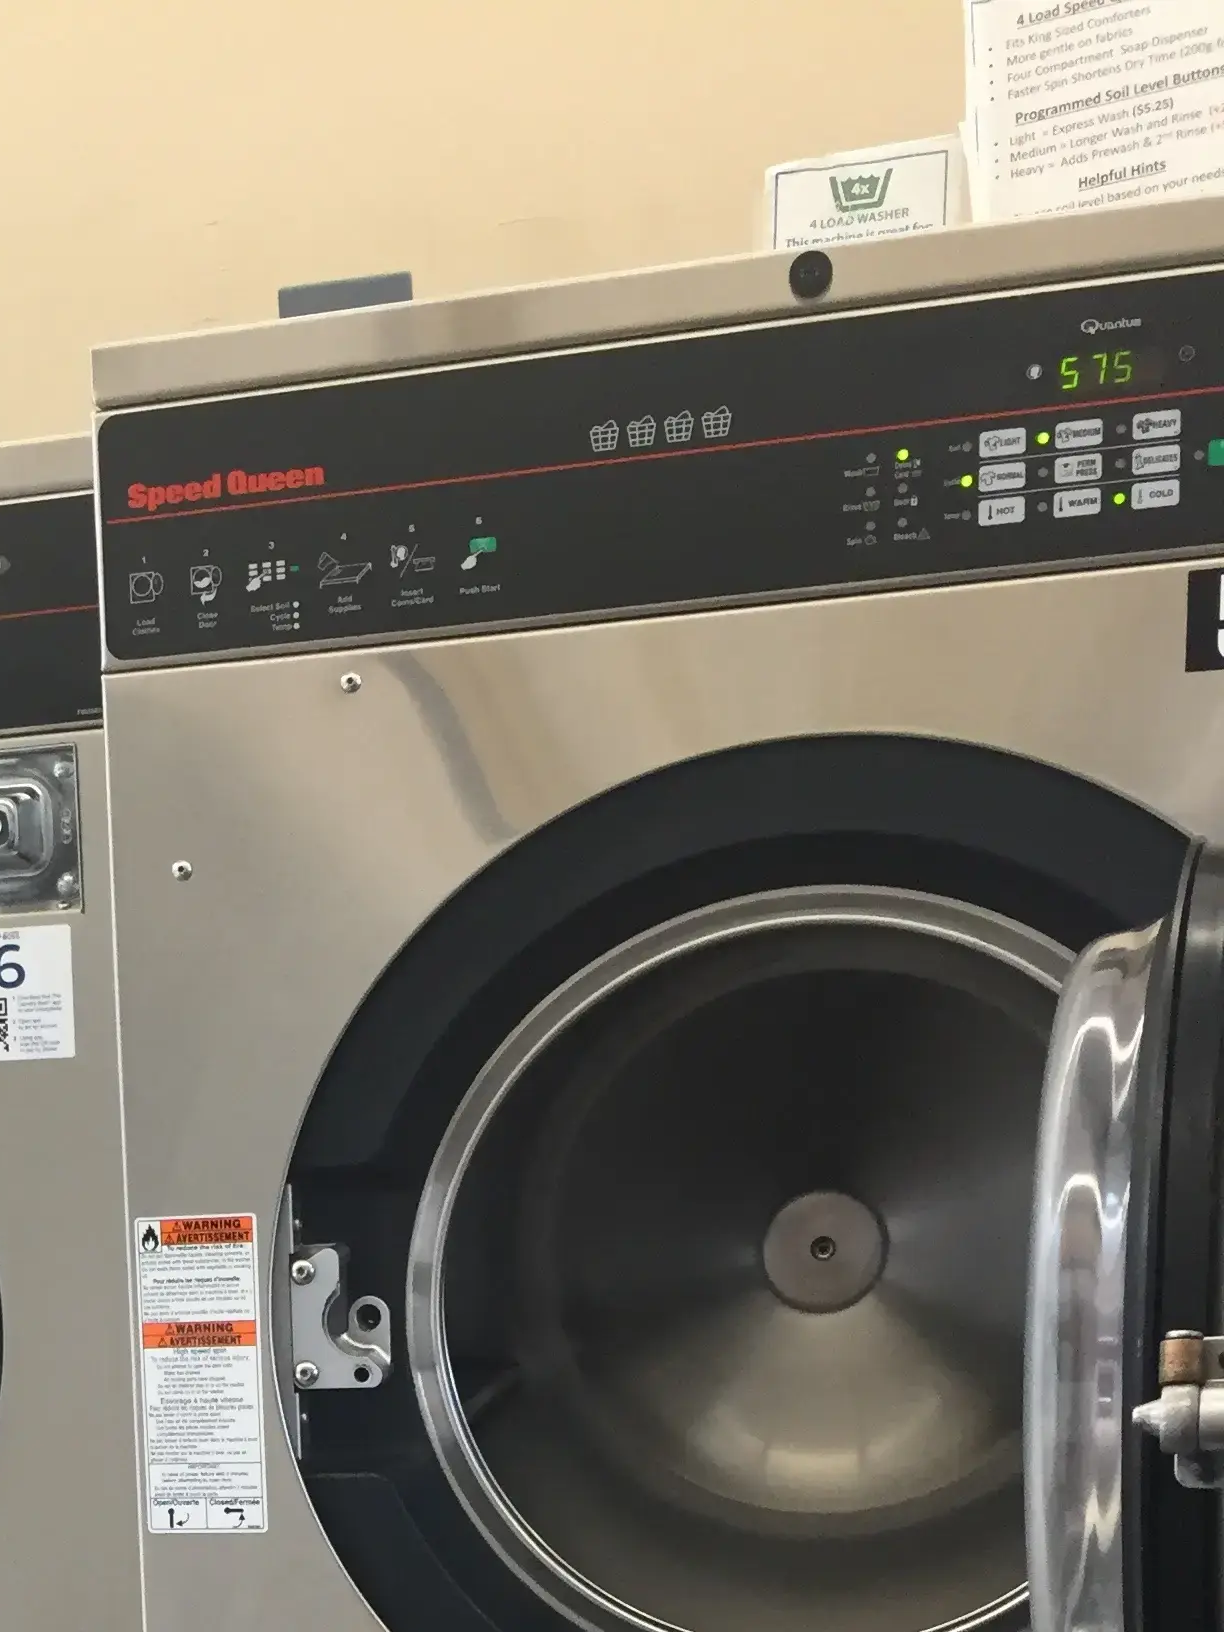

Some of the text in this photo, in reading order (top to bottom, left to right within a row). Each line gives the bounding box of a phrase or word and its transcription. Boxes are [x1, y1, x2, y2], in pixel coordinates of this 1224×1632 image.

[1017, 14, 1025, 26] 4
[1029, 4, 1060, 23] Load
[1006, 38, 1025, 50] Fits
[1028, 30, 1052, 45] King
[1087, 6, 1151, 30] Comforters
[1006, 27, 1134, 67] More gentle on fabrics
[1007, 69, 1032, 83] Four
[1035, 48, 1114, 76] Compartment
[1120, 38, 1148, 55] Soap
[1151, 26, 1208, 47] Dispenser
[1007, 85, 1040, 100] Faster
[1044, 76, 1068, 92] Spin
[1071, 65, 1122, 84] Shortens
[1125, 57, 1145, 72] Dry
[1148, 51, 1176, 66] Time
[1015, 64, 1224, 124] Programmed Soil Level Buttons
[1010, 132, 1036, 147] Light
[1052, 118, 1095, 137] Express
[1097, 109, 1129, 125] Wash
[1132, 96, 1174, 119] ($5.25)
[1010, 143, 1057, 163] Medium
[1070, 131, 1108, 149] Longer
[1111, 121, 1143, 138] Wash
[1146, 116, 1167, 131] and
[1010, 162, 1044, 180] Heavy
[1060, 153, 1089, 168] Adds
[1091, 140, 1140, 160] Prewash
[1143, 136, 1152, 148] &
[1078, 159, 1167, 189] Helpful Hints
[1078, 194, 1104, 208] level
[1107, 186, 1141, 203] based
[1144, 184, 1159, 195] on
[1162, 177, 1188, 192] your
[809, 207, 910, 229] 4 LOAD WASHER
[1152, 418, 1177, 429] HEAVY
[999, 437, 1021, 447] LIGHT
[127, 466, 325, 511] Speed Queen
[1149, 489, 1174, 499] COLD
[996, 506, 1015, 515] HOT
[1068, 497, 1098, 508] WARM
[182, 1219, 241, 1231] WARNING
[176, 1231, 250, 1244] AVERTISSEMENT
[176, 1322, 233, 1334] WARNING
[170, 1335, 242, 1346] AVERTISSEMENT
[153, 1499, 199, 1508] Open/Ouverte
